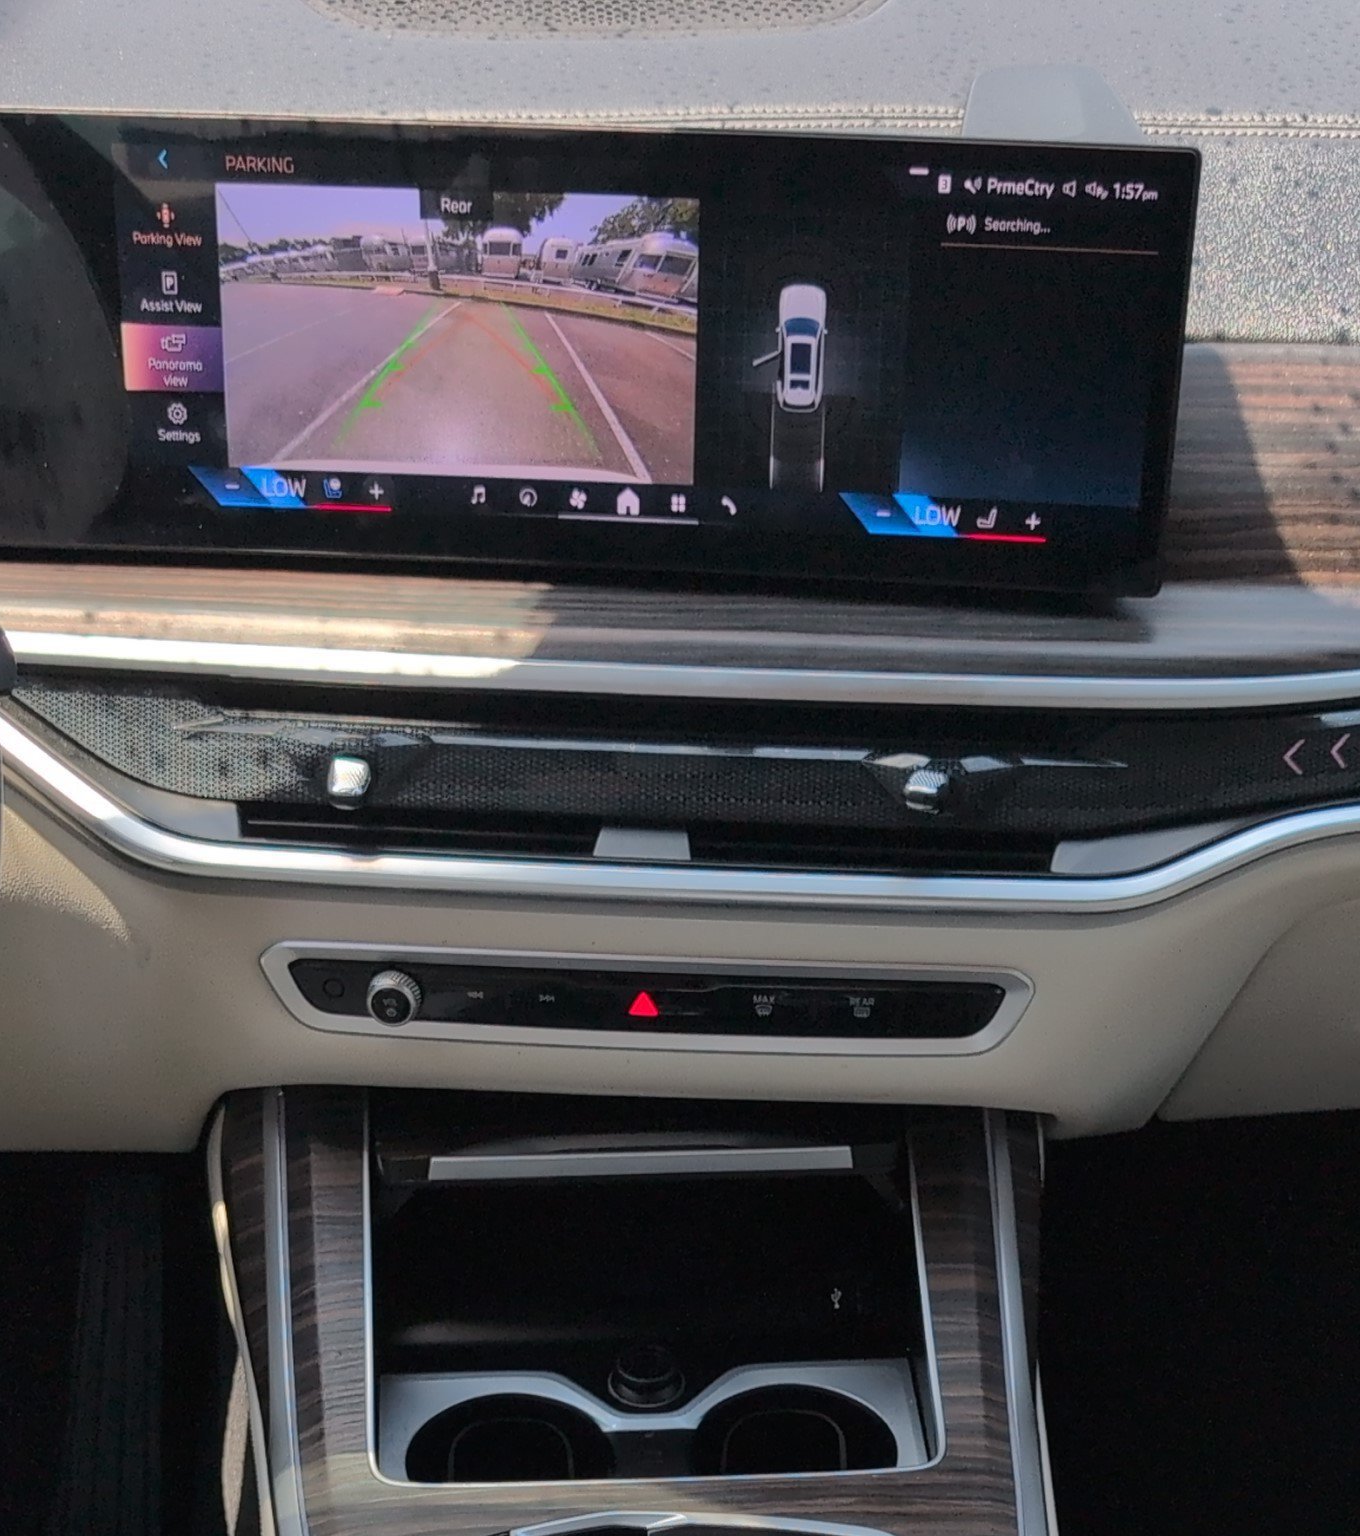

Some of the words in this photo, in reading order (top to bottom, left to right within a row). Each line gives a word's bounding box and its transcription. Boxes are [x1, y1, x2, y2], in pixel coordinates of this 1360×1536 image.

[225, 155, 295, 174] PARKING
[986, 177, 1056, 200] PrmeCtry
[440, 197, 472, 214] Rear
[132, 231, 173, 248] Parking
[174, 232, 202, 246] View
[141, 298, 173, 313] Assist
[175, 299, 202, 313] View
[148, 358, 203, 372] Panorama
[158, 428, 201, 444] Settings
[262, 477, 307, 498] LOW
[914, 504, 962, 527] LOW
[752, 994, 776, 1005] MAX
